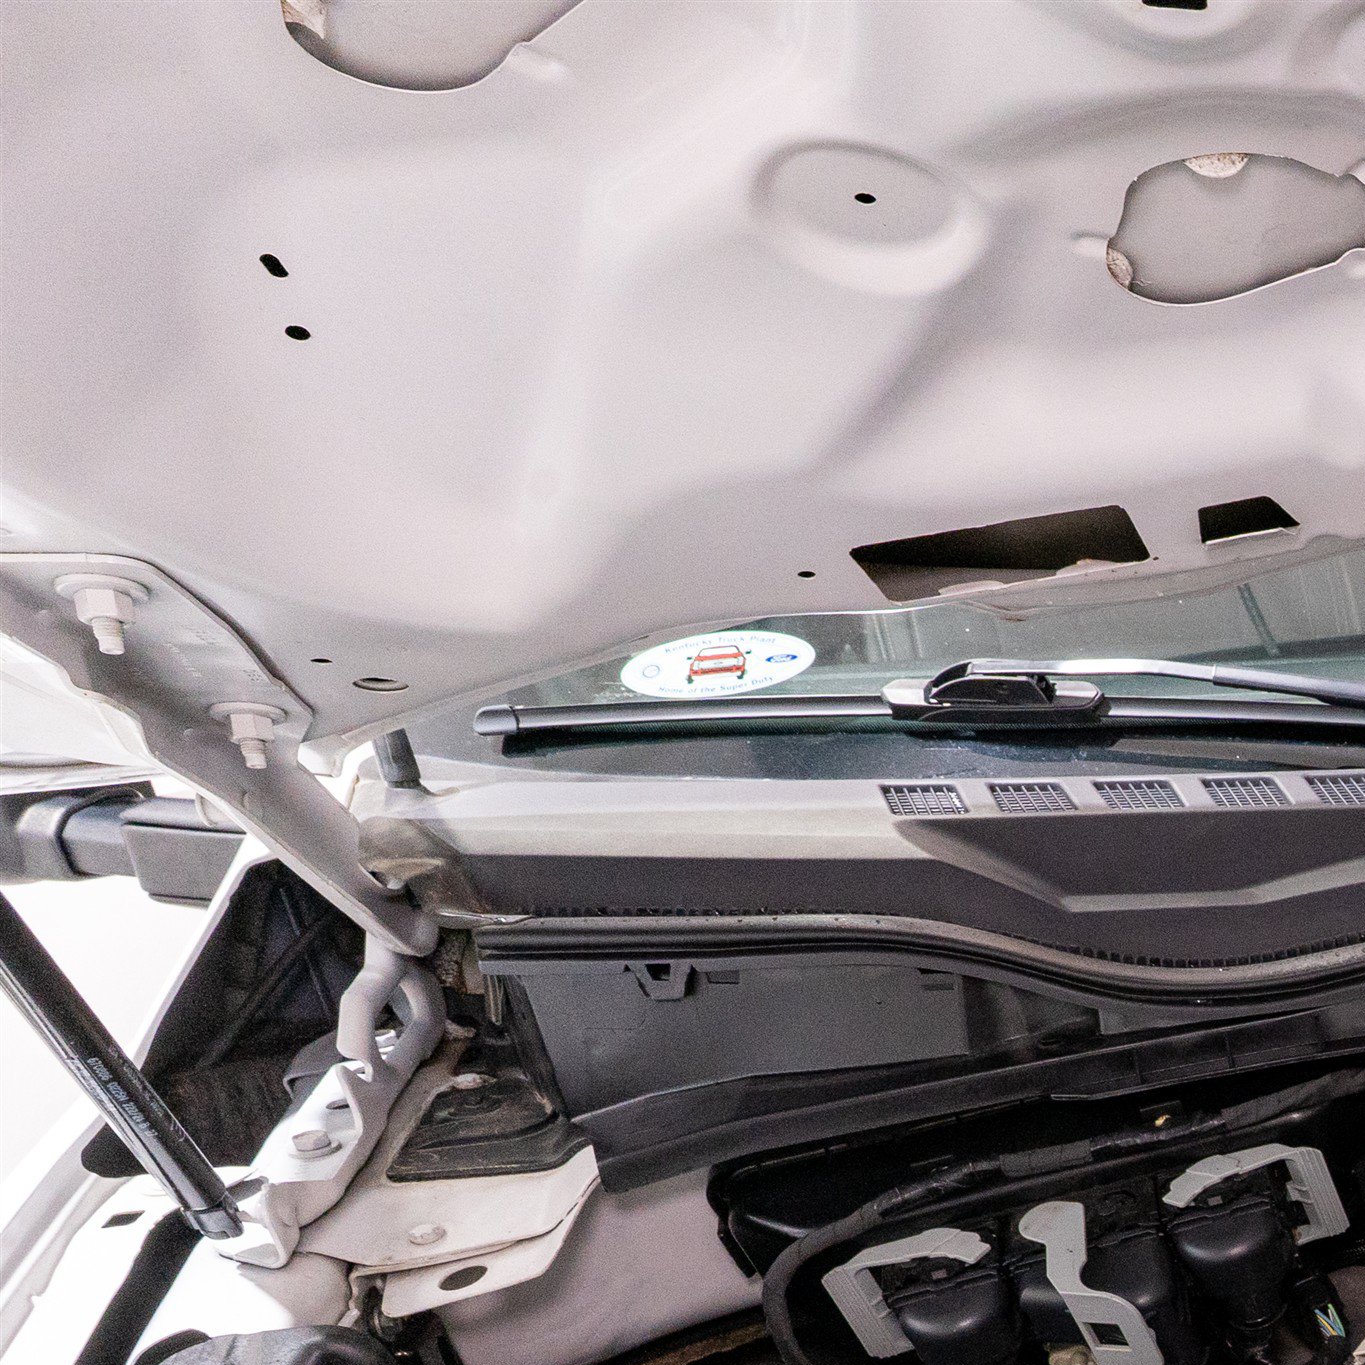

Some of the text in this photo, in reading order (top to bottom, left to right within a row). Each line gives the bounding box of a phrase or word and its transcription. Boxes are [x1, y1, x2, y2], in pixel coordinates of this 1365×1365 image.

[665, 635, 776, 654] Kentucky Truck Plant
[751, 677, 773, 688] Duty
